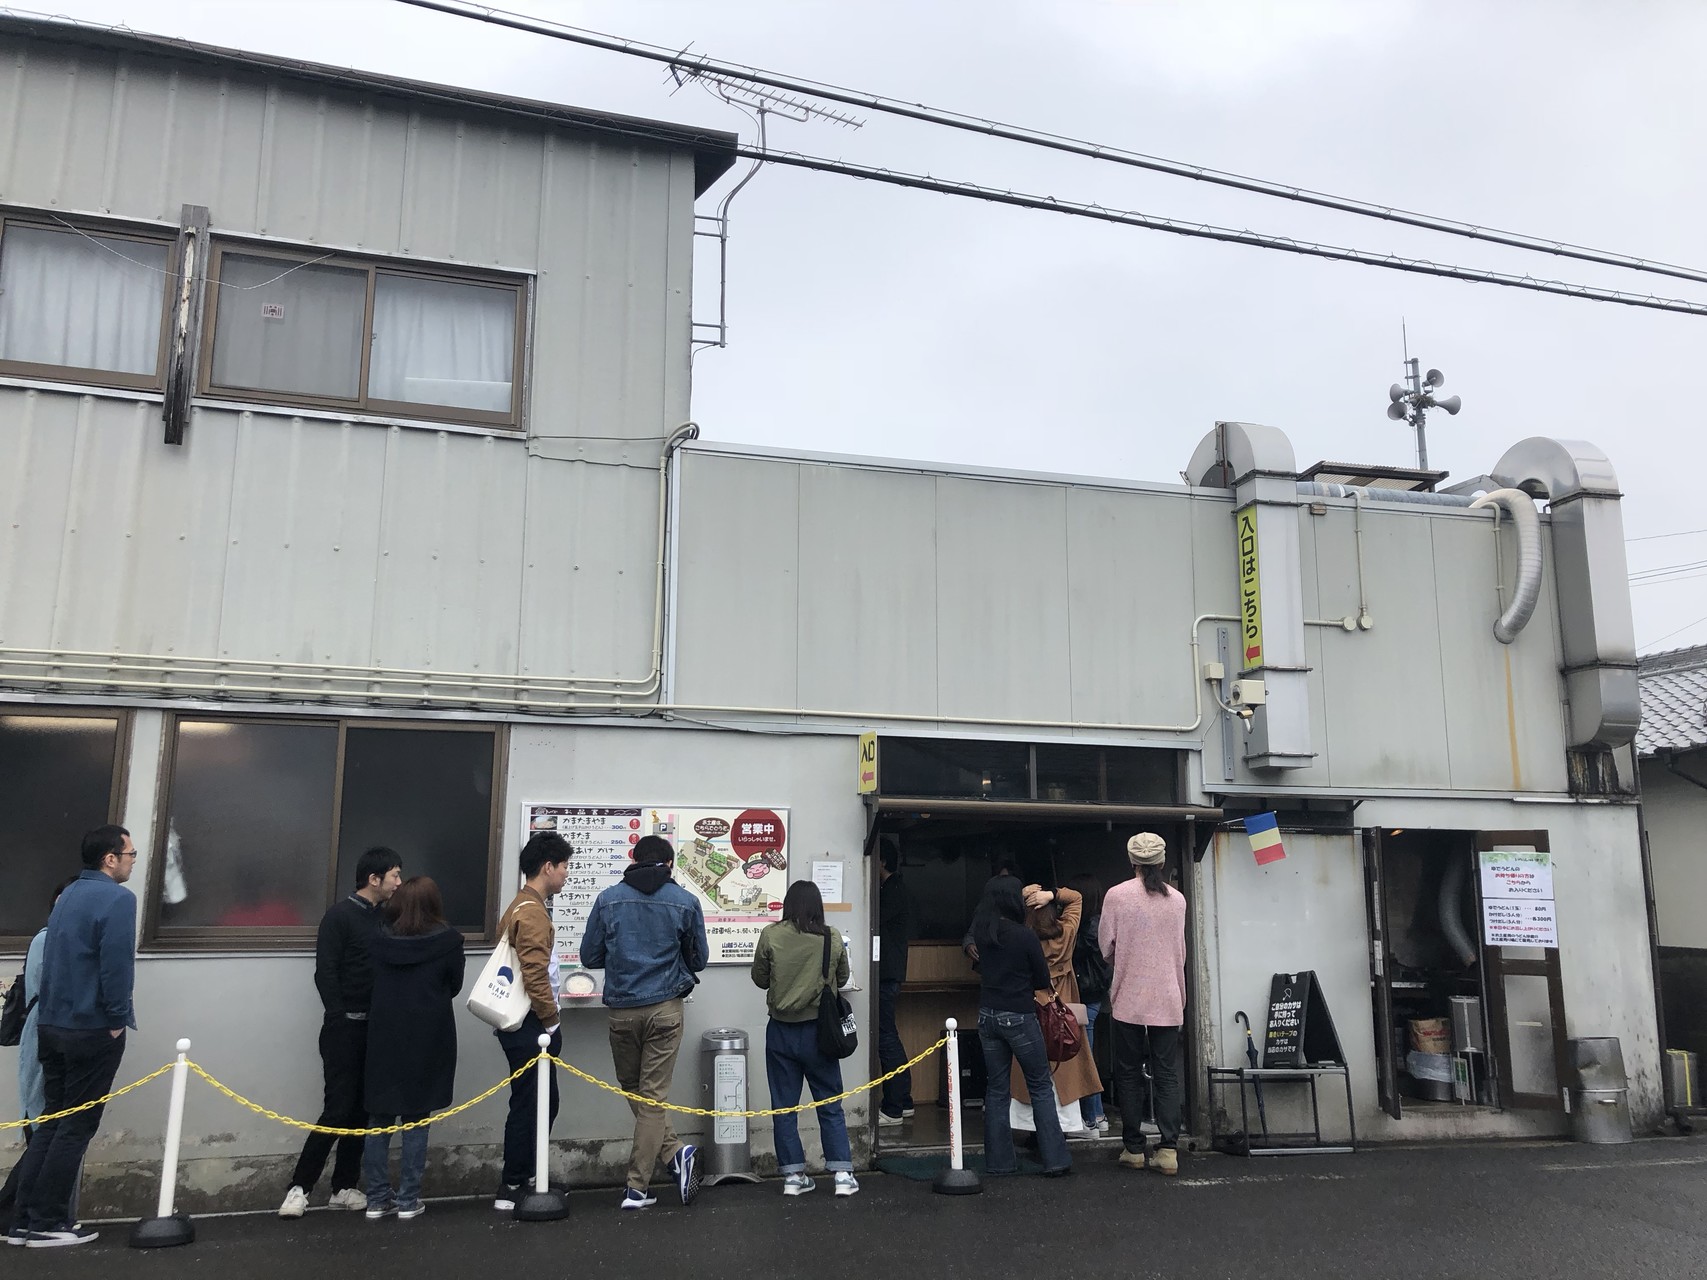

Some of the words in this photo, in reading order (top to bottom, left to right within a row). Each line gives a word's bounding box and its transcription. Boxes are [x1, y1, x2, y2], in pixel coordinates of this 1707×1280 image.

[1240, 515, 1258, 639] 入口はこちら
[861, 740, 875, 763] 入口
[562, 817, 606, 825] かまたまやま
[741, 823, 774, 834] 営業中
[558, 908, 580, 916] つきみ
[1272, 1001, 1301, 1010] ご自分のカサは
[1274, 1010, 1296, 1019] 手に持って
[1270, 1019, 1299, 1027] お入りください
